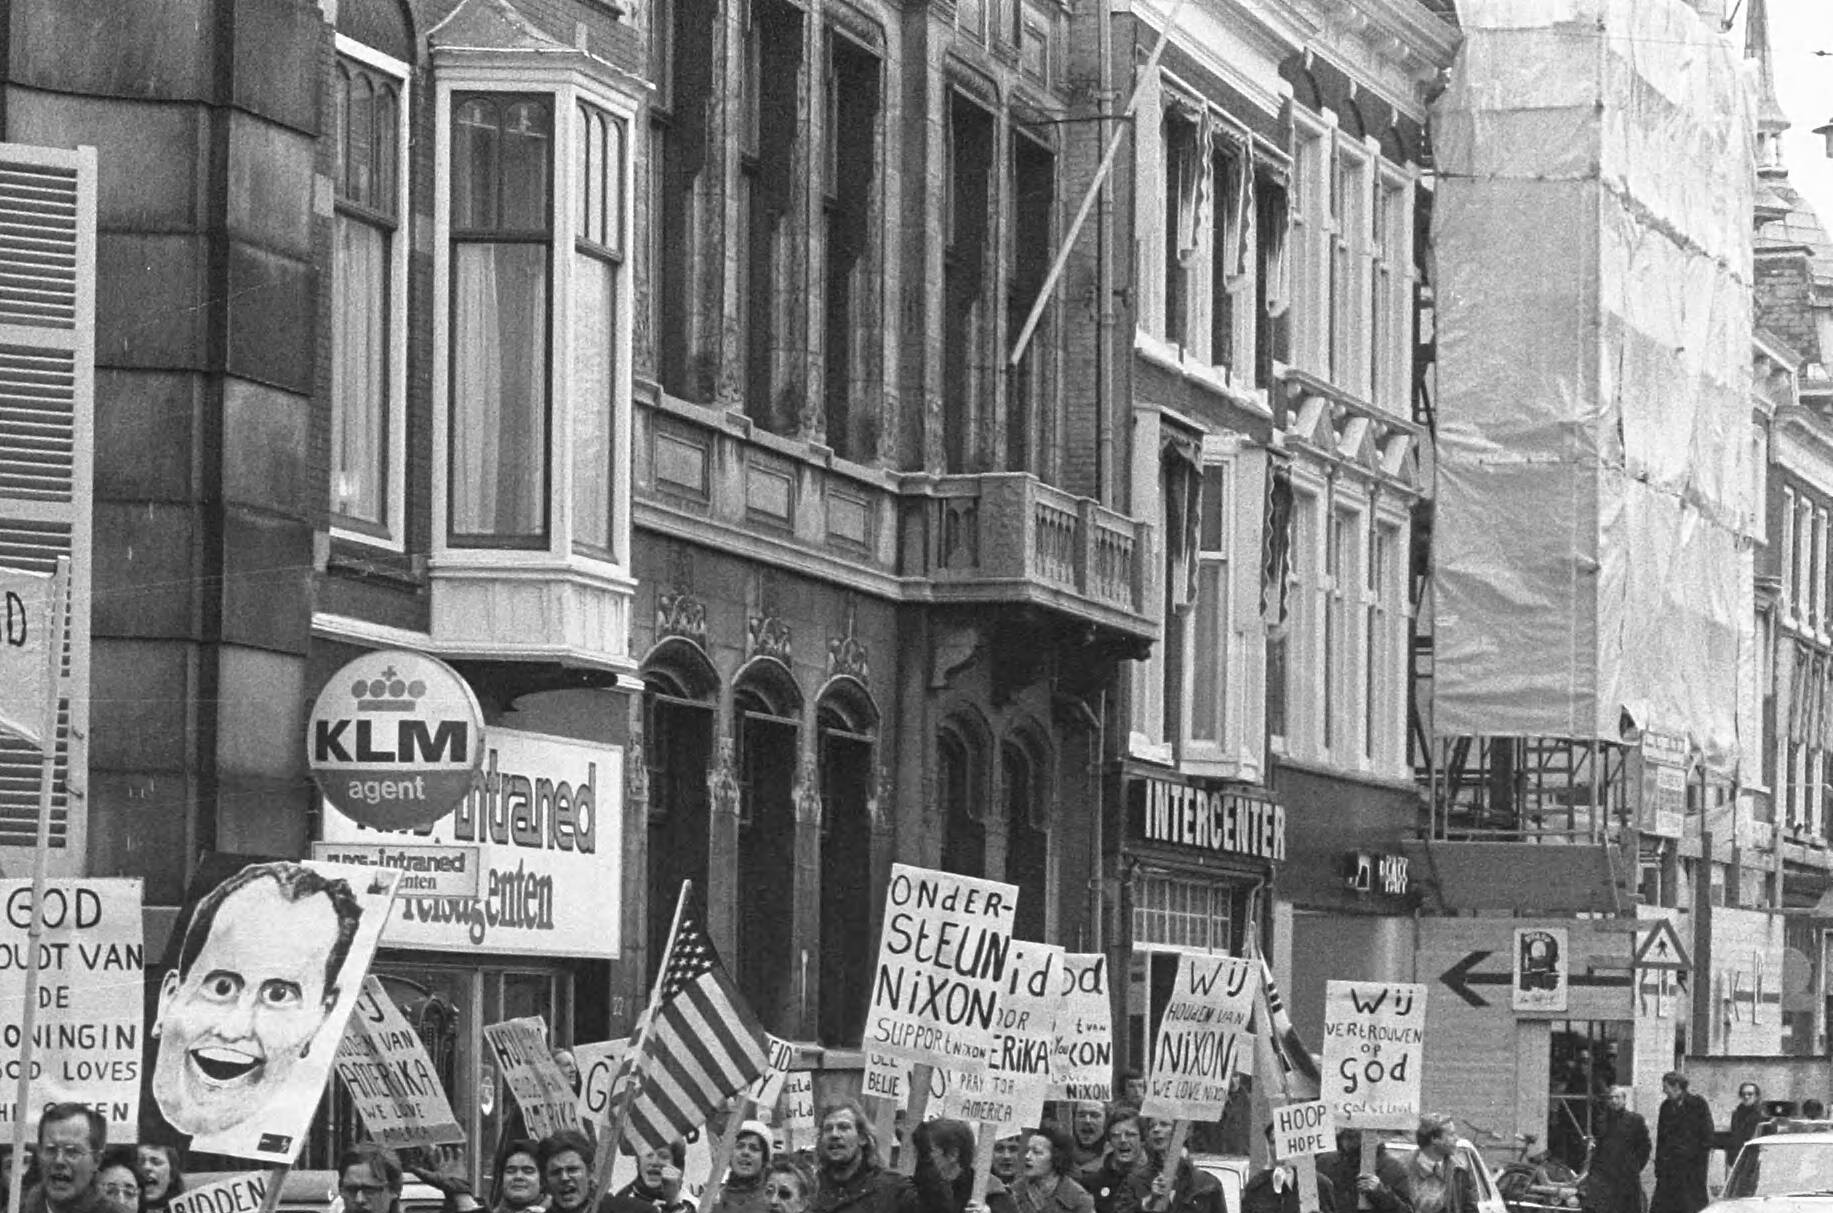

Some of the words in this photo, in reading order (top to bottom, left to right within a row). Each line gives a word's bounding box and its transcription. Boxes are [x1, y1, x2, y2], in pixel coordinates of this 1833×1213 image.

[315, 719, 468, 763] KLM
[349, 776, 425, 804] agent
[1144, 779, 1286, 861] INTERCENTER
[6, 887, 102, 929] GOD
[79, 943, 143, 970] VAN
[38, 985, 71, 1009] DE
[379, 1029, 415, 1052] VAN
[63, 1060, 138, 1082] LOVES
[1280, 1105, 1327, 1133] HOOP
[1287, 1135, 1327, 1154] HOPE
